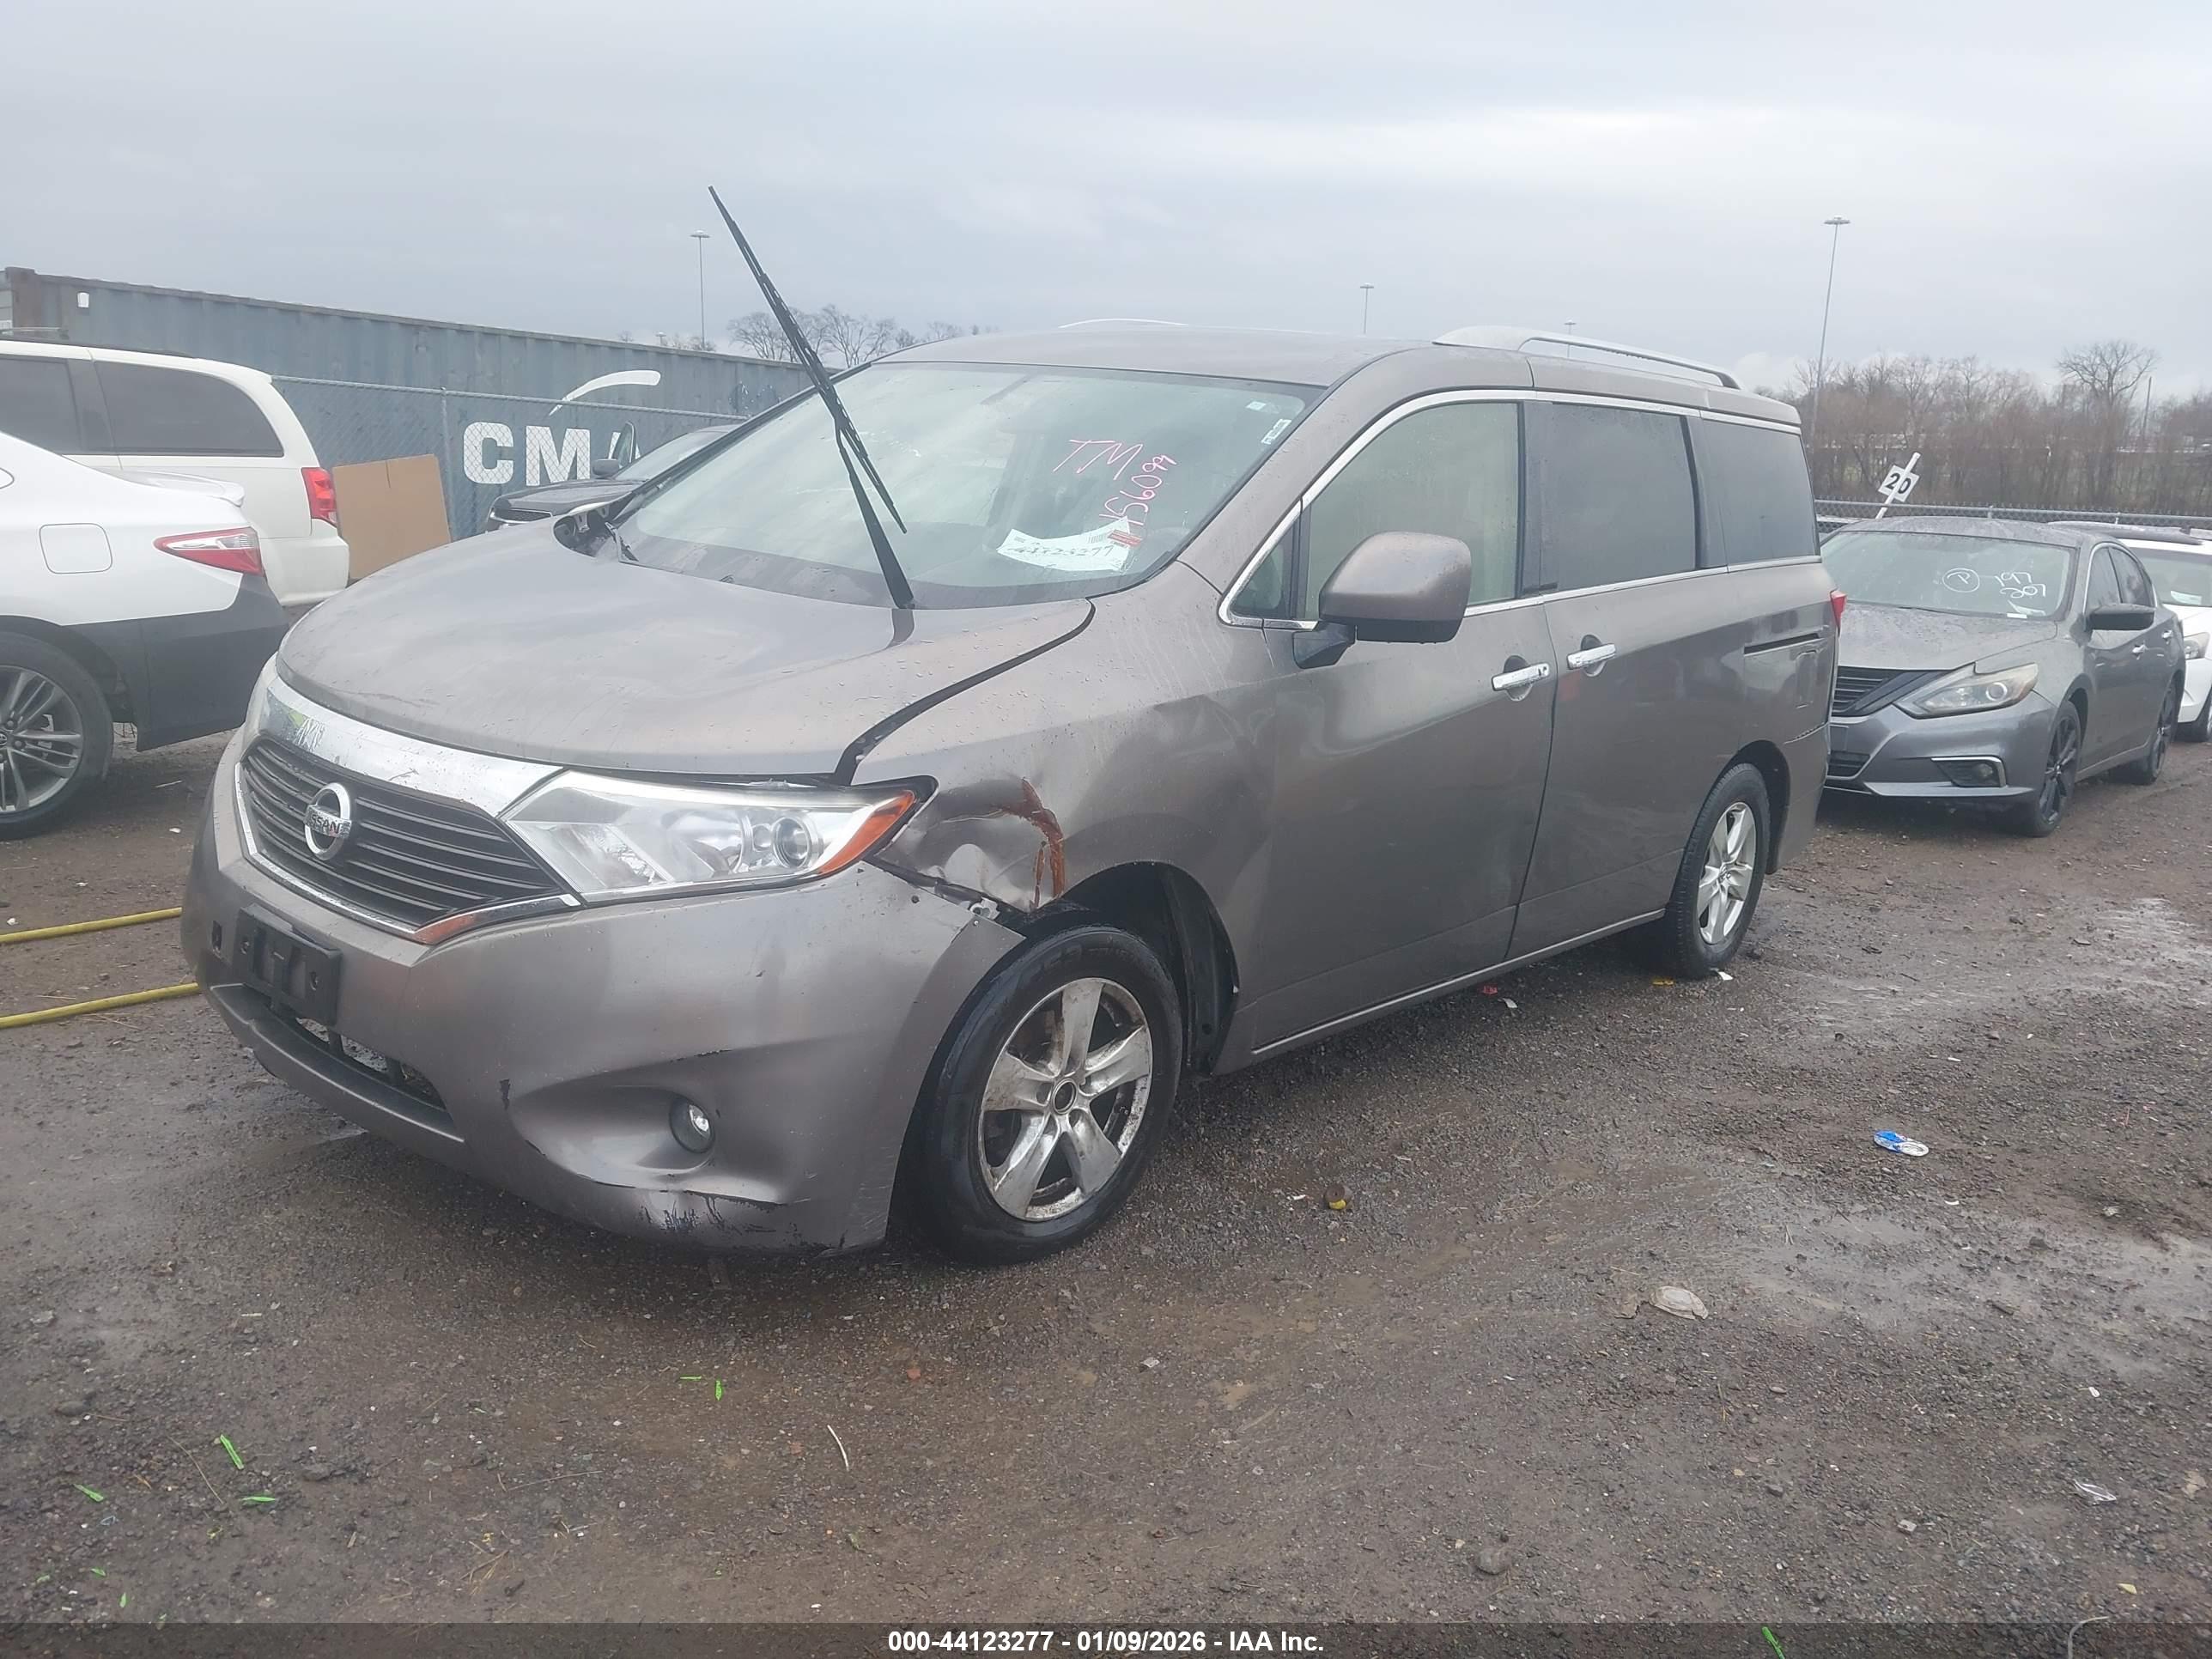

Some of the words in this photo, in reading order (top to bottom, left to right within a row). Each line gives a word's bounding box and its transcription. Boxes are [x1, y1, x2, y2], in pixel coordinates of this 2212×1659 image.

[1053, 440, 1144, 481] TM
[1885, 472, 1911, 494] 20
[1999, 583, 2046, 599] 207
[307, 811, 342, 835] SSAN
